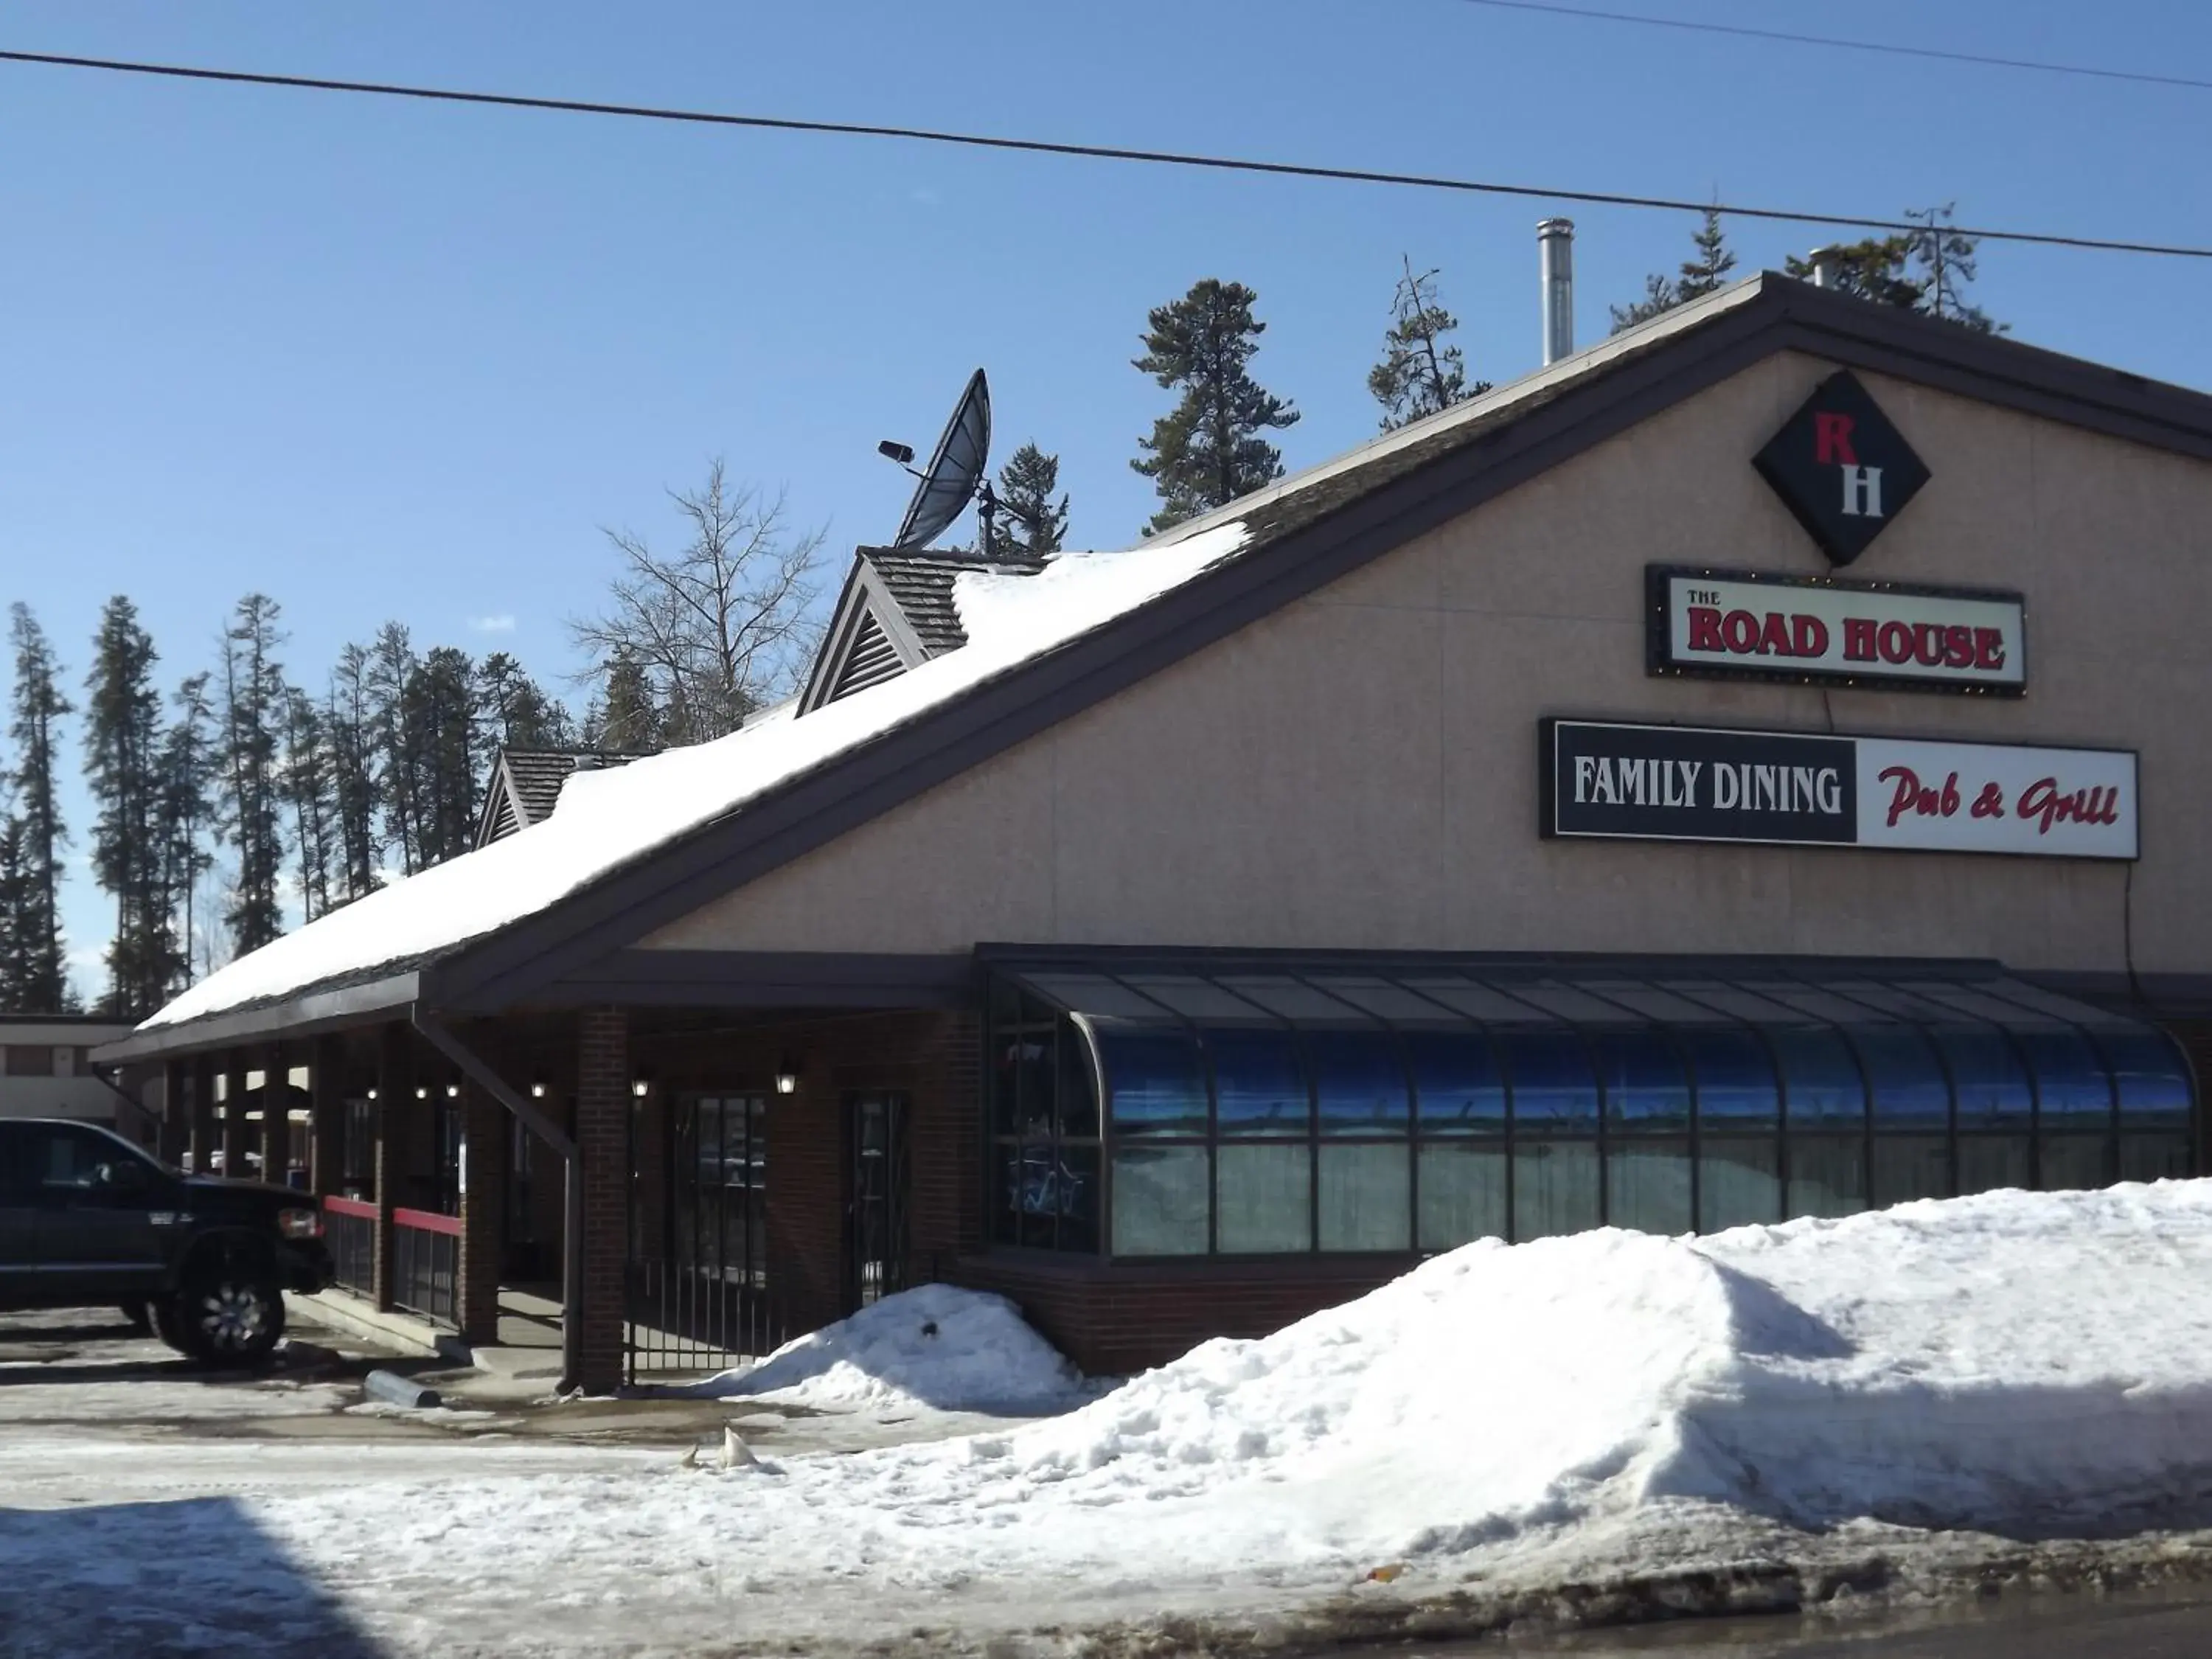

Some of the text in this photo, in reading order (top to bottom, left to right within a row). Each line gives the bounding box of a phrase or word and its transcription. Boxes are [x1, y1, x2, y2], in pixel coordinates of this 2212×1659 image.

[1817, 413, 1857, 464] R
[1842, 465, 1885, 518] H
[1688, 591, 1720, 605] THE
[1688, 608, 2006, 670] ROAD HOUSE
[1573, 756, 1842, 815] FAMILY DINING
[1878, 765, 2119, 835] Pub & Grill
